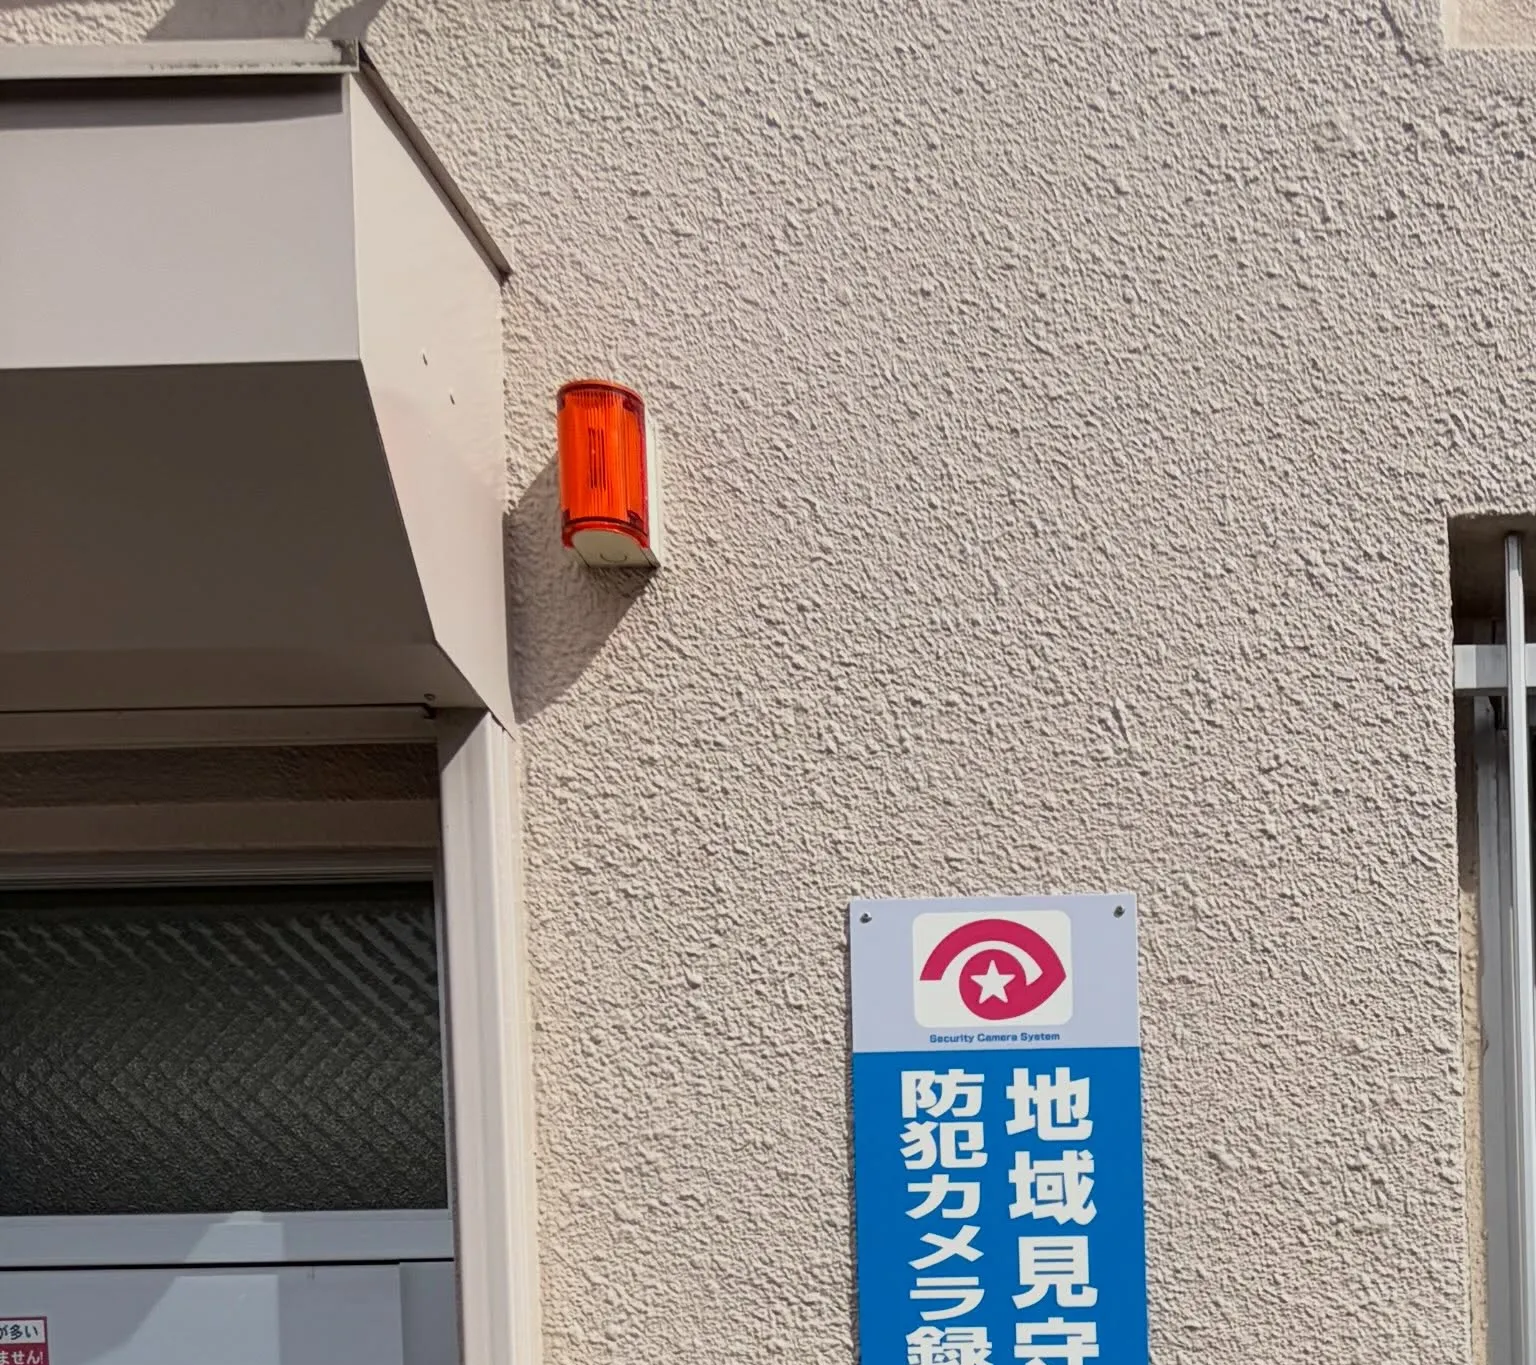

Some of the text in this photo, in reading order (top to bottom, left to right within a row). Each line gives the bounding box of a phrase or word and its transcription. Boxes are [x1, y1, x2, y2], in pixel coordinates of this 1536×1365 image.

[929, 1032, 1060, 1044] Security Camera System
